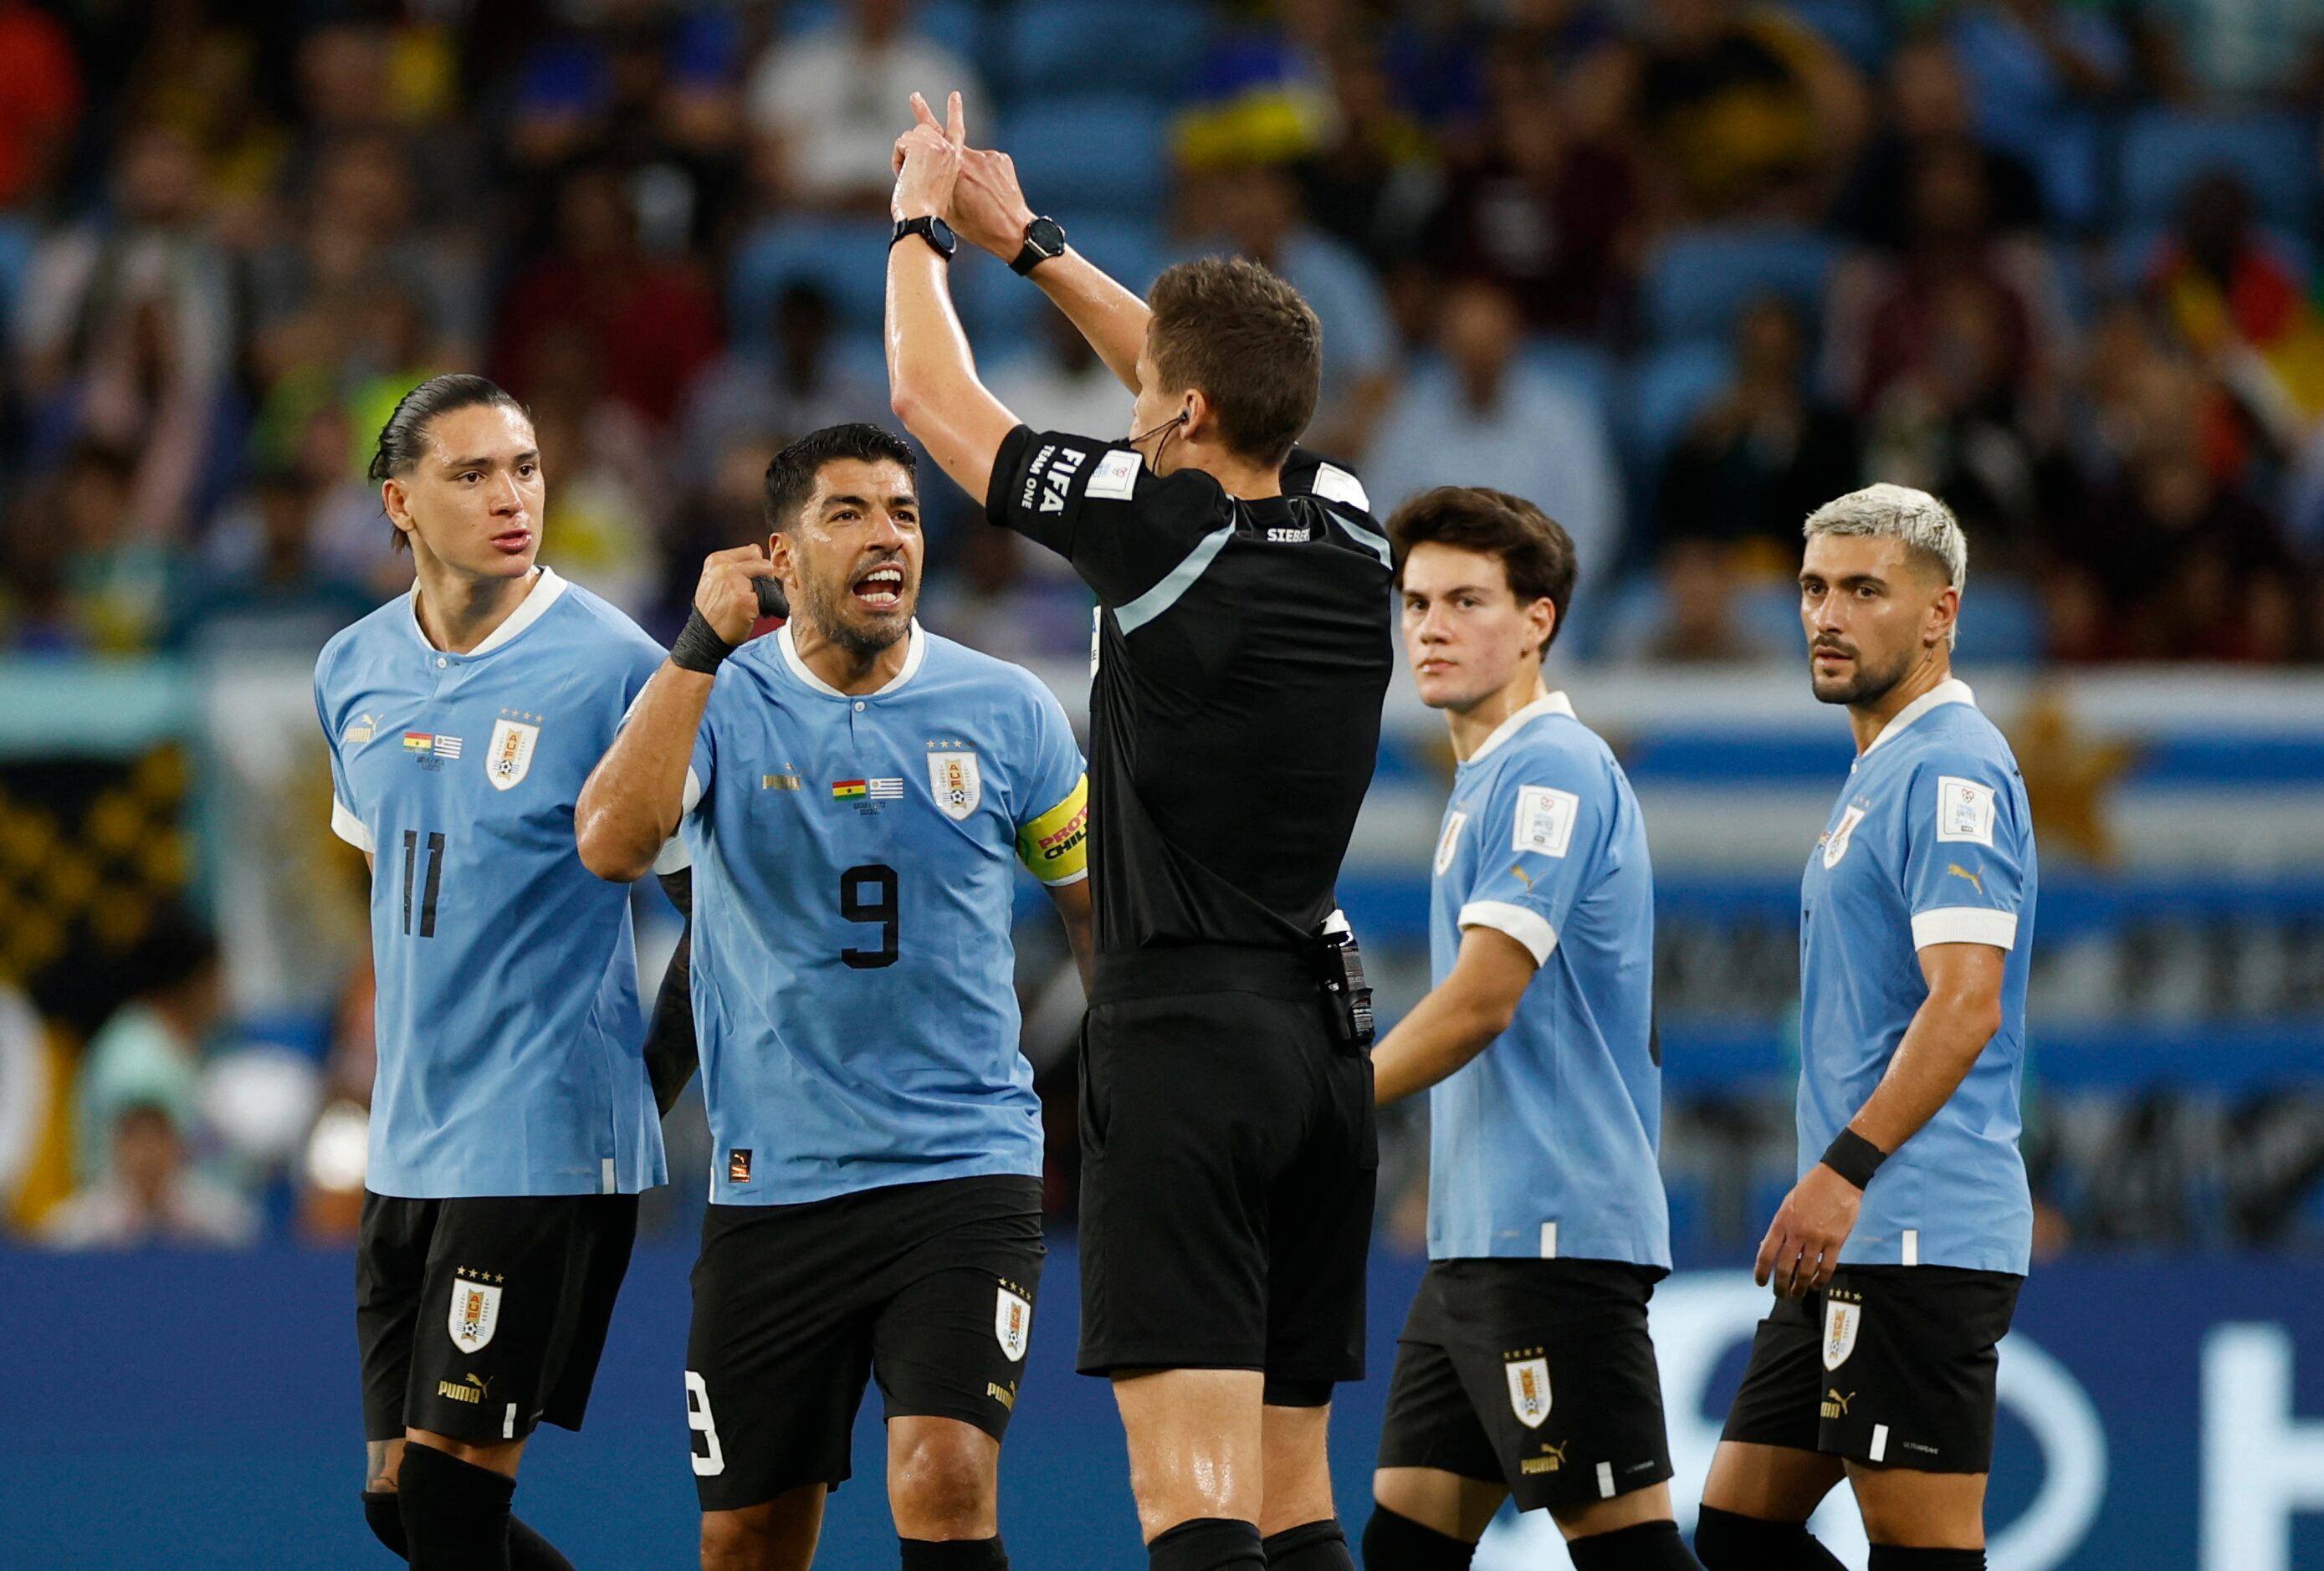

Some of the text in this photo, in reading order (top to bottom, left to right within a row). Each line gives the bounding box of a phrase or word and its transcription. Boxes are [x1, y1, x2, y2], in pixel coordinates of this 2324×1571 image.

[1021, 444, 1056, 509] TEAM ONE
[1039, 448, 1086, 511] FIFA
[1267, 527, 1311, 543] SIEBER
[504, 734, 518, 758] AUF
[950, 764, 962, 788] AUF
[1044, 823, 1087, 860] CHIL
[403, 829, 445, 939] 11
[841, 864, 898, 969] 9
[467, 1295, 479, 1319] AUF
[438, 1380, 481, 1405] PUMA
[1820, 1401, 1840, 1419] MA
[684, 1370, 725, 1476] 9
[1521, 1456, 1559, 1475] PUMA
